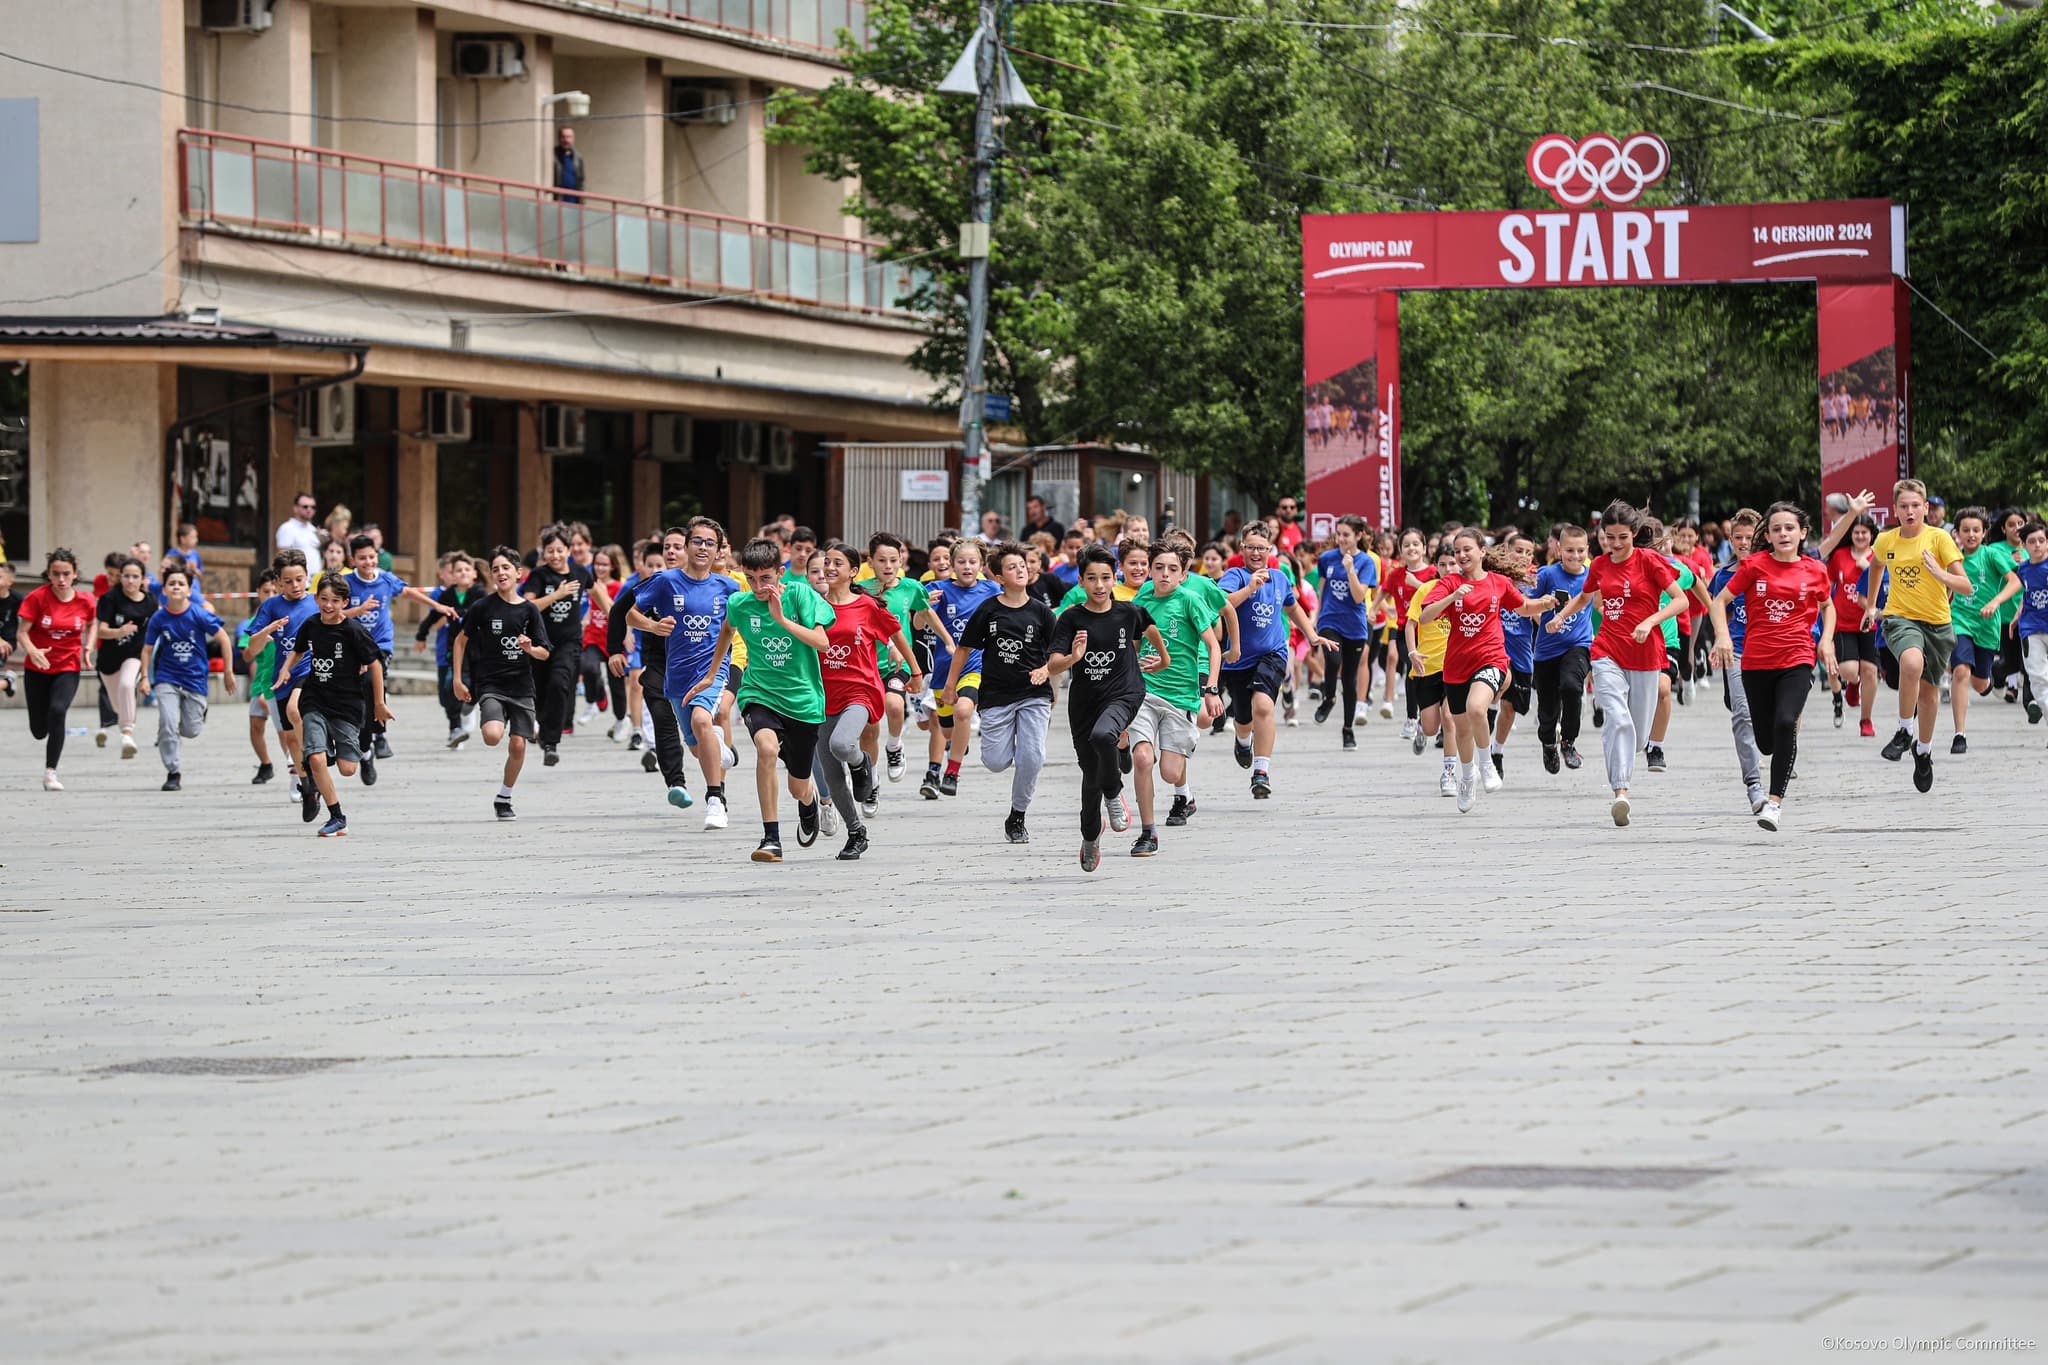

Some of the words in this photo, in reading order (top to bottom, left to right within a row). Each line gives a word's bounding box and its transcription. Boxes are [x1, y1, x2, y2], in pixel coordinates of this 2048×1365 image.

[1753, 226, 1768, 244] 14
[1771, 224, 1835, 245] QERSHOR
[1838, 222, 1872, 241] 2024
[1329, 240, 1385, 258] OLYMPIC
[1387, 239, 1413, 257] DAY
[1498, 209, 1689, 284] START
[1379, 409, 1389, 458] DAY
[1380, 464, 1391, 535] MPIC
[1459, 625, 1482, 633] OLYMPIC
[765, 653, 792, 661] OLYMPIC
[998, 651, 1020, 660] OLYMPIC
[1004, 657, 1015, 665] DAY
[824, 658, 848, 668] OLYMPIC
